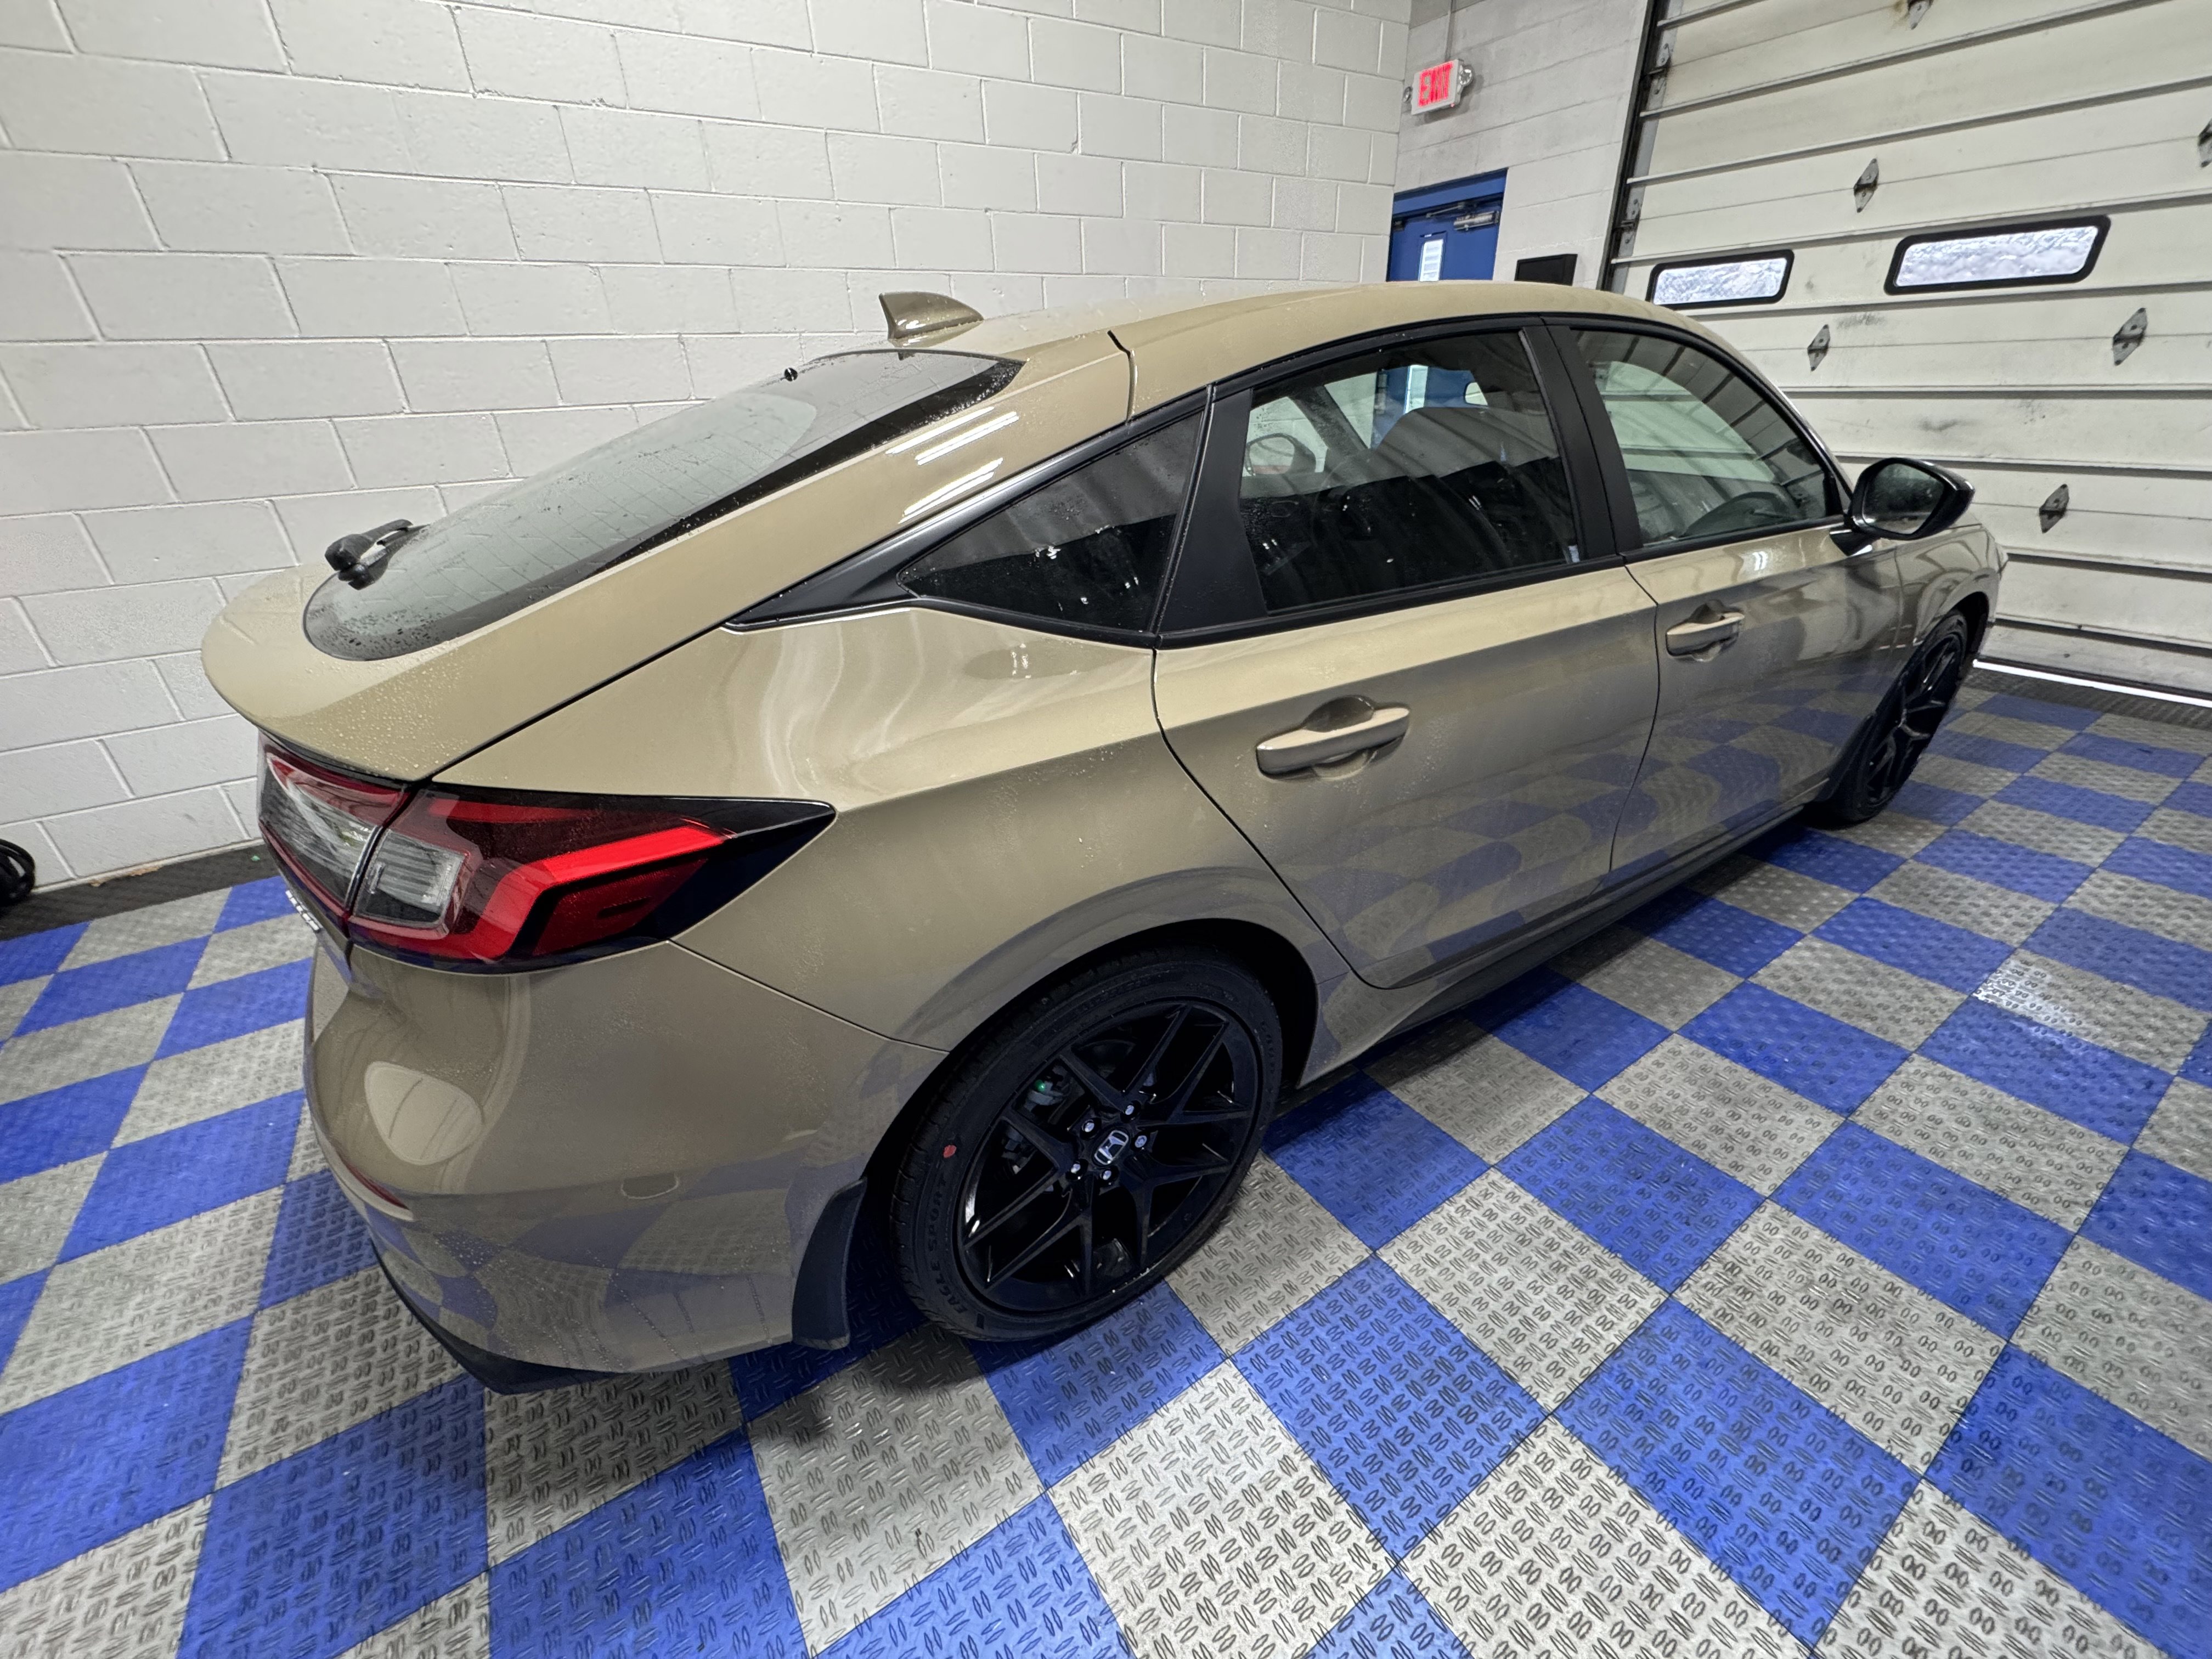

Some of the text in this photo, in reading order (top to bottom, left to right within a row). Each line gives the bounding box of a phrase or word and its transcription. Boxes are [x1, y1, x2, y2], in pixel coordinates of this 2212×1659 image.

[1418, 61, 1453, 107] EXIT
[928, 1174, 968, 1313] EAGLE SPORT
